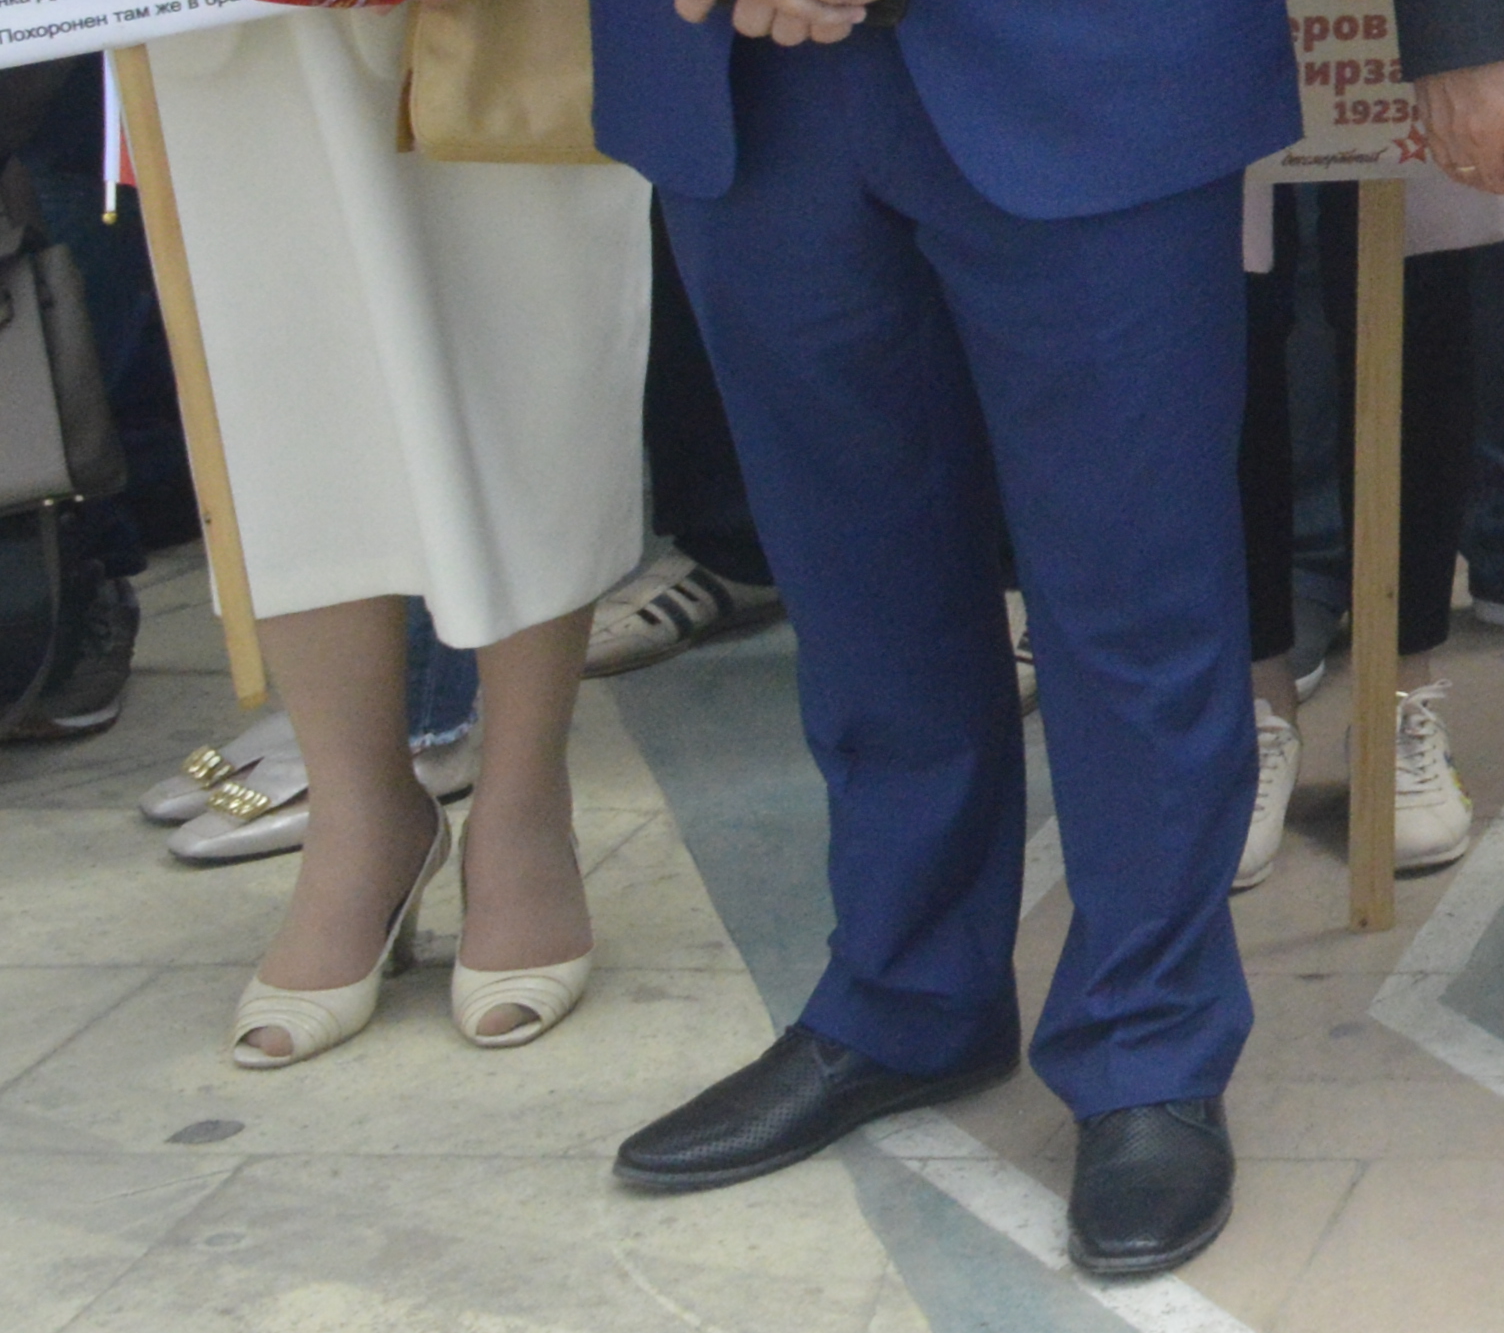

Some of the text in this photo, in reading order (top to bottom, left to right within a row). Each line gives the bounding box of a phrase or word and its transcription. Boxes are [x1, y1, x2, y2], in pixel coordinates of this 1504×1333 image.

[0, 12, 108, 44] Похоронен
[113, 6, 151, 23] там
[1299, 58, 1402, 96] ирза
